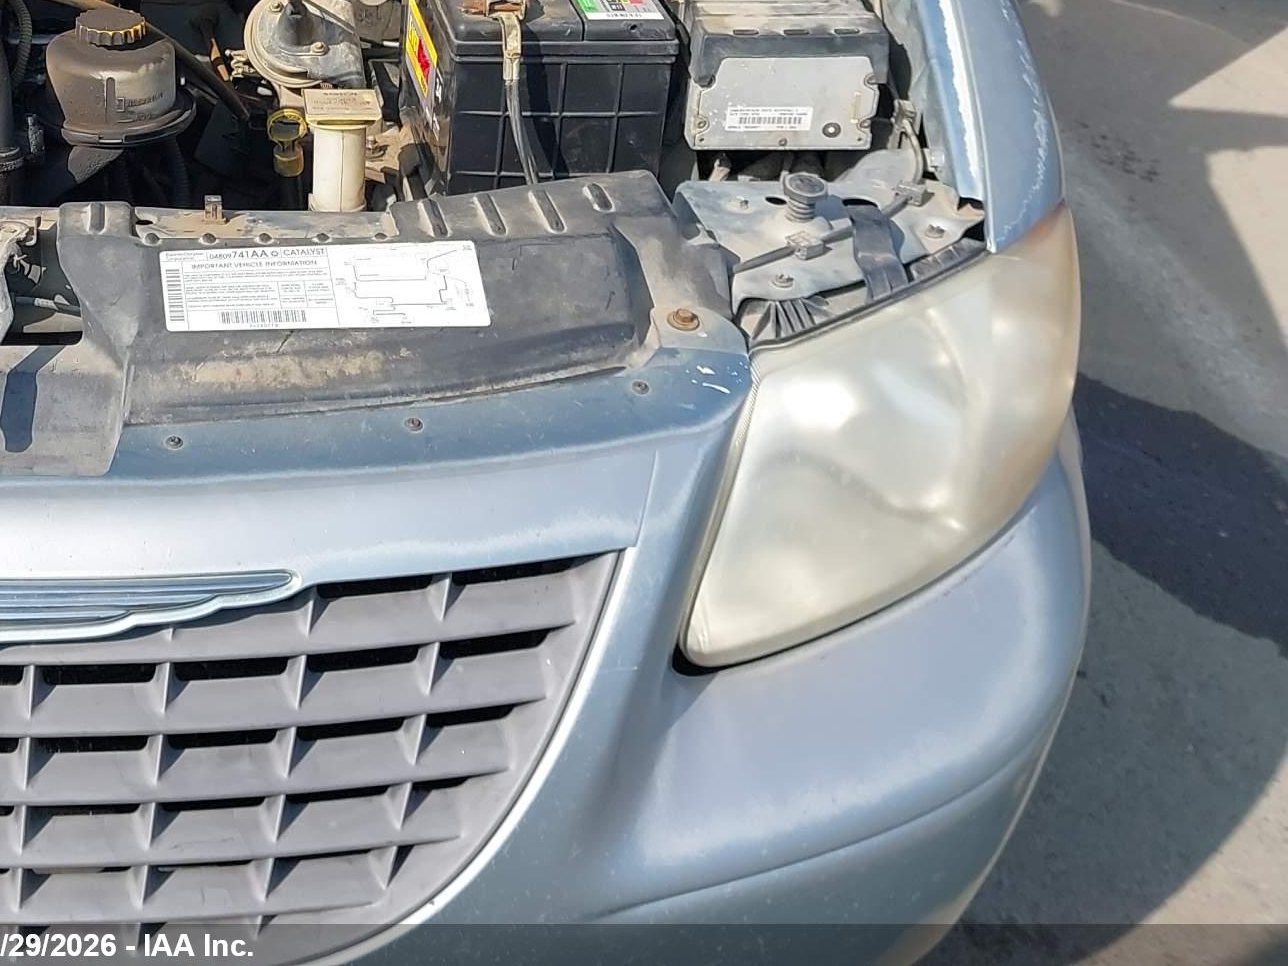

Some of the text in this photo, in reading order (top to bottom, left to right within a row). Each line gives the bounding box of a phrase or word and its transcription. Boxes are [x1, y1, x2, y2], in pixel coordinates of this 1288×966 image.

[282, 248, 325, 257] CATALYST
[191, 260, 318, 270] IMPORTANT VEHICLE INFORMATION
